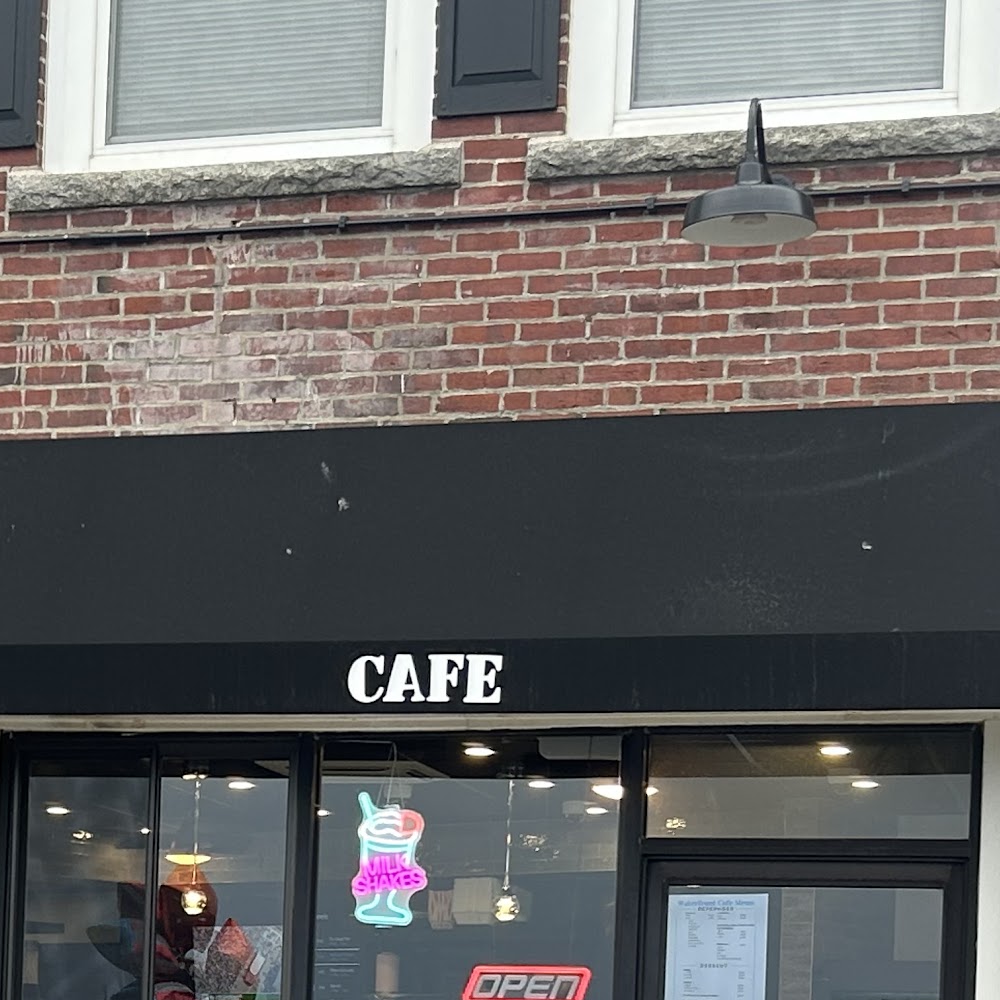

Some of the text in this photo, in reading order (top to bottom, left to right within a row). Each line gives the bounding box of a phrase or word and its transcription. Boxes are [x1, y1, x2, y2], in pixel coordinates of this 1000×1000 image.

[347, 653, 503, 704] CAFE
[364, 854, 412, 877] MILK
[353, 867, 426, 895] SHAKES
[472, 973, 580, 1000] OPEN
